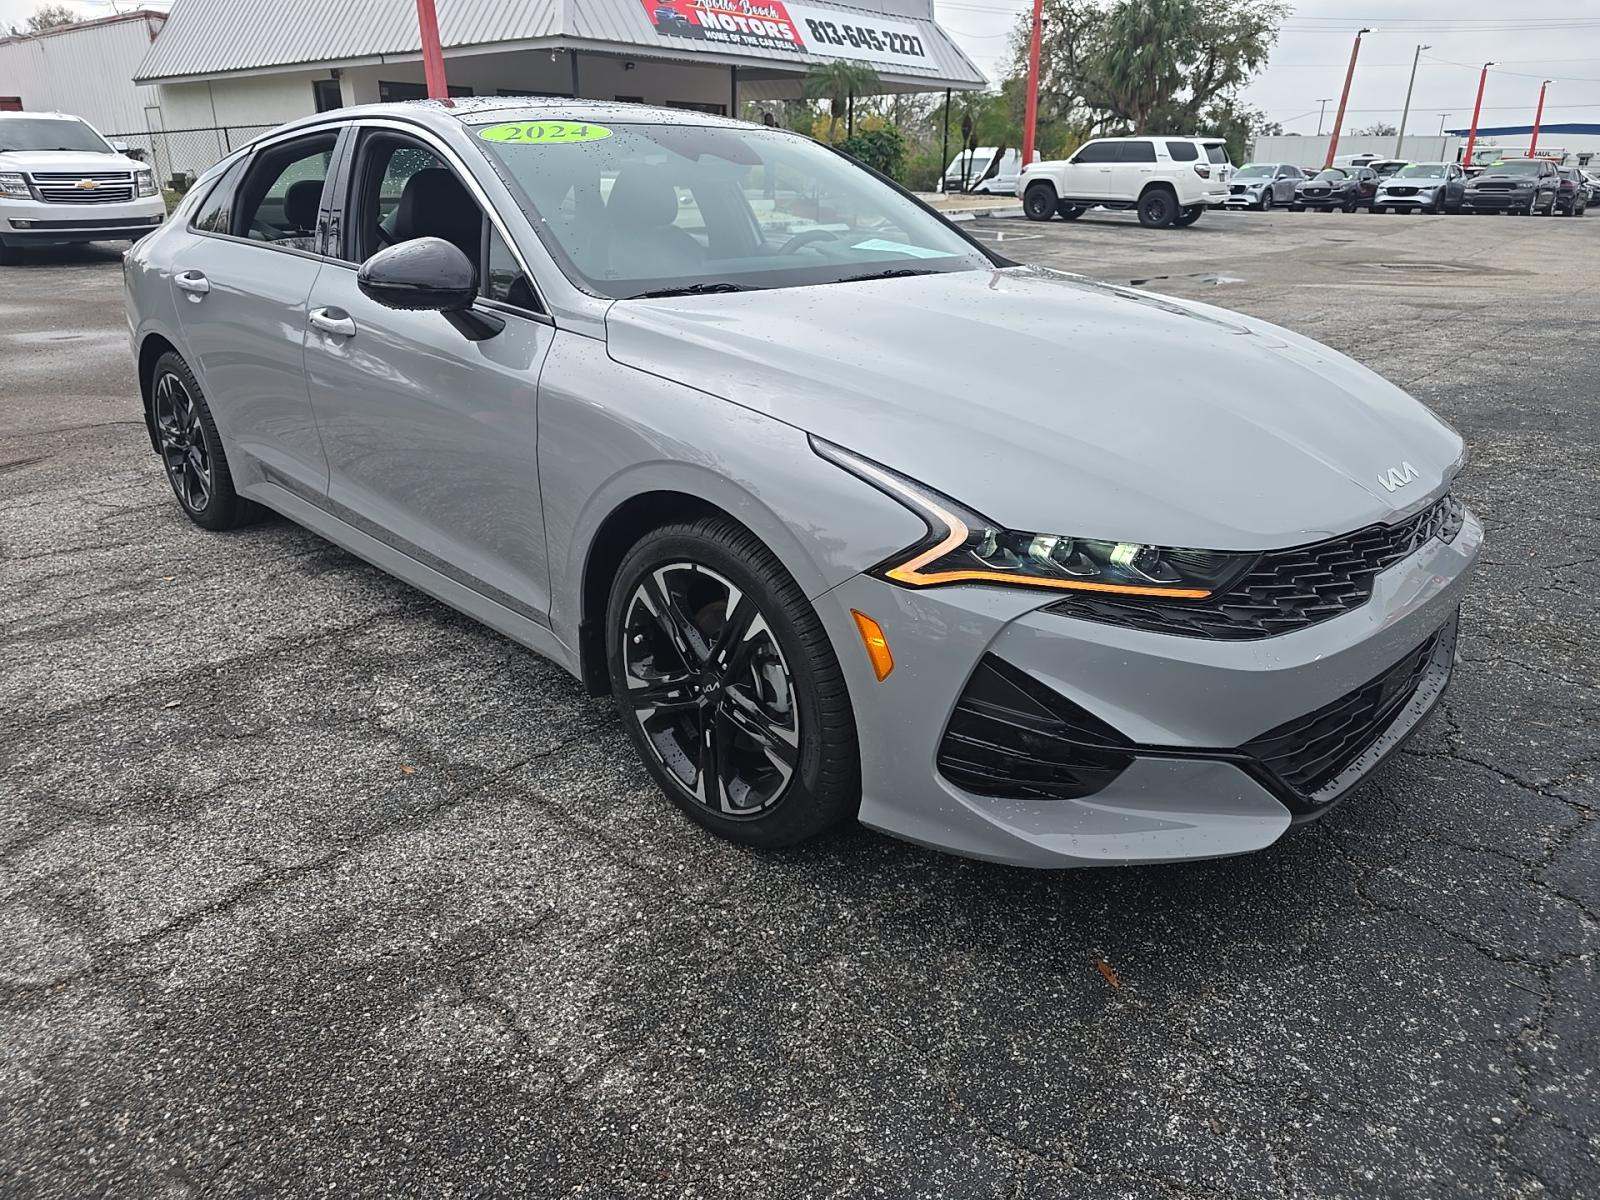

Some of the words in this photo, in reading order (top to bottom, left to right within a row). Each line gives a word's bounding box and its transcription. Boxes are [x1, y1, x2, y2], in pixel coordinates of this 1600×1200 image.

[739, 0, 779, 18] Beach
[695, 10, 795, 40] MOTORS
[704, 30, 730, 42] HOME
[731, 34, 741, 42] OF
[741, 35, 759, 45] THE
[759, 38, 775, 47] CAR
[805, 18, 925, 57] 813-645-2227
[504, 125, 589, 140] 2024
[1377, 461, 1420, 493] KIA
